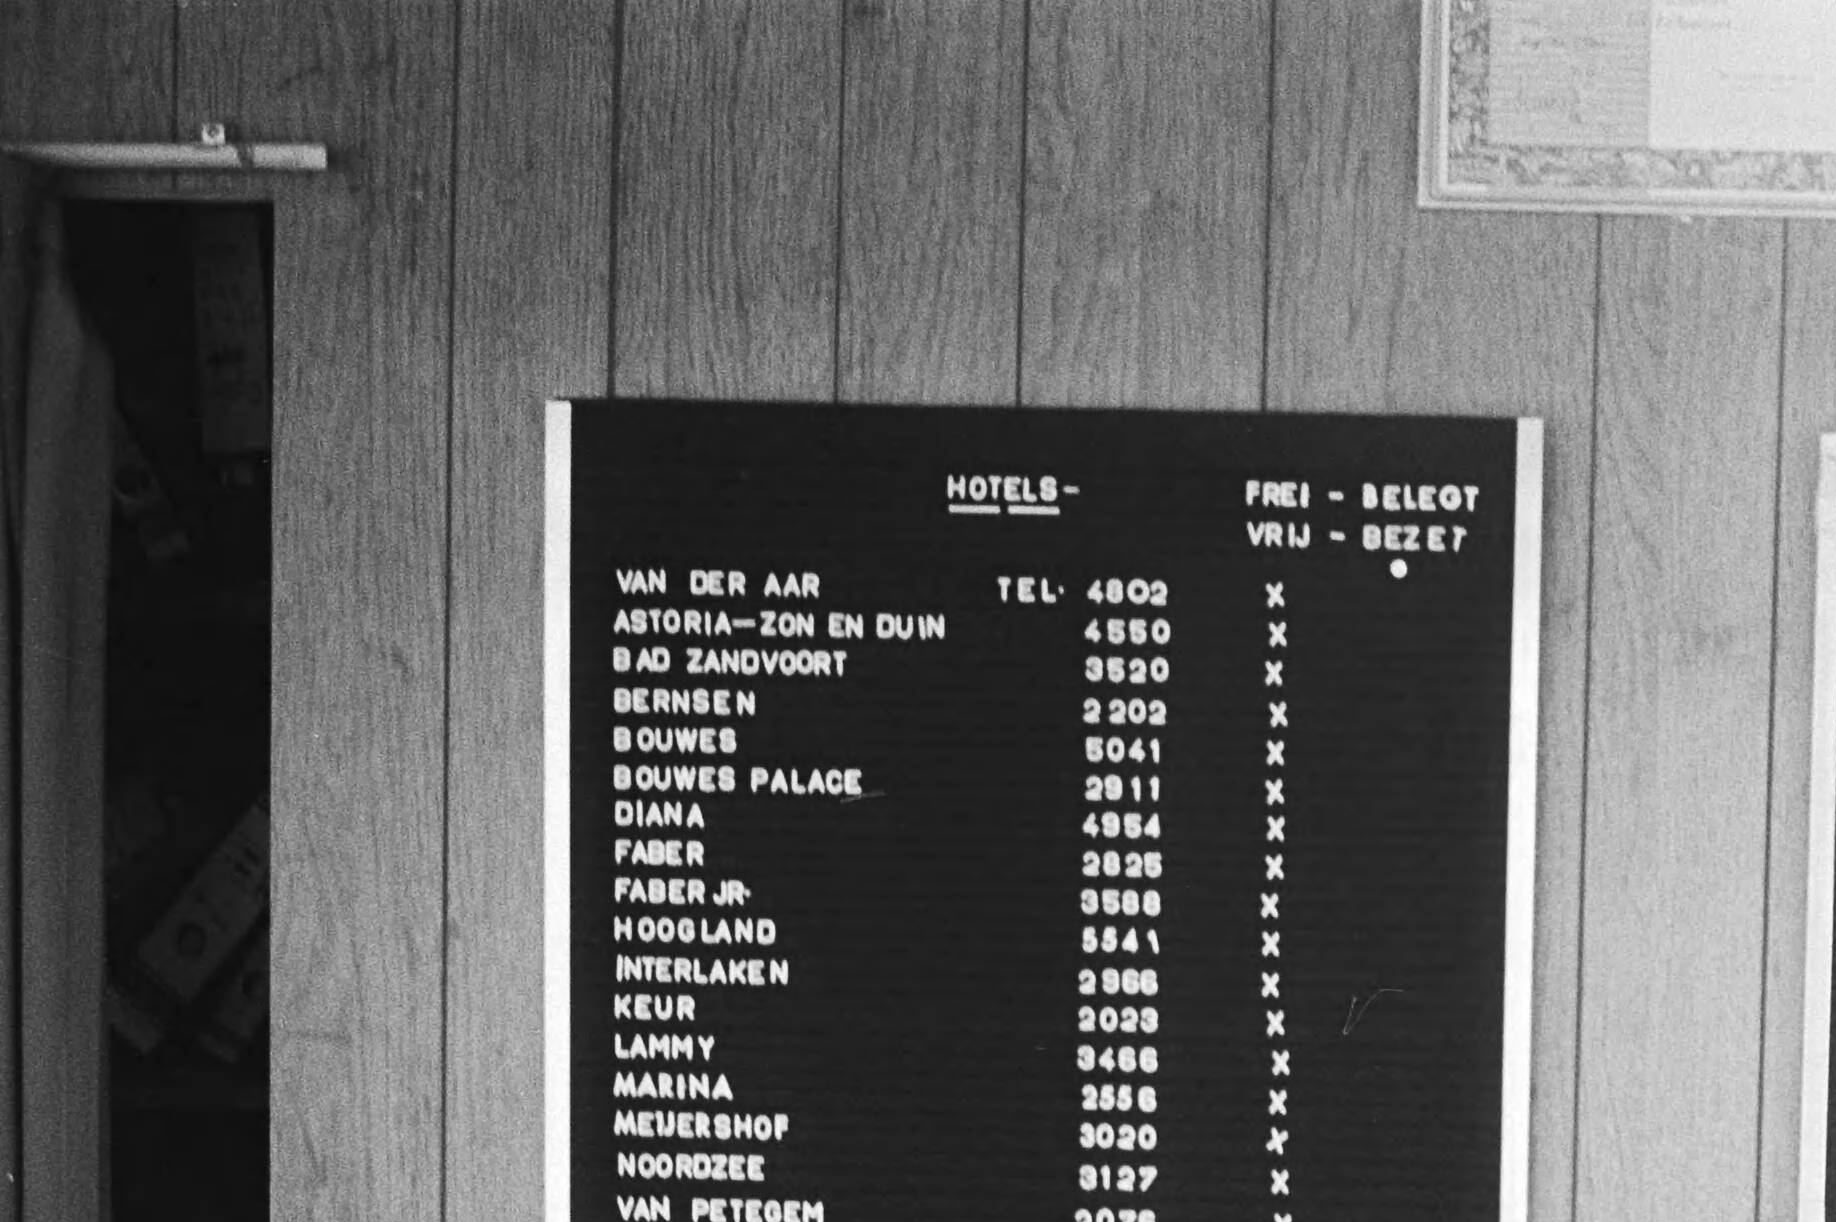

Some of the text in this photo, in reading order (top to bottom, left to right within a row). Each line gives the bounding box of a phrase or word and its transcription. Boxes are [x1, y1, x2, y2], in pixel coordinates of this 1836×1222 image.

[1245, 479, 1311, 509] FREI
[1361, 482, 1480, 513] BELEGT
[1246, 521, 1311, 549] VRIJ
[1362, 524, 1468, 553] BEZET
[616, 568, 667, 595] VAN
[689, 569, 746, 597] DER
[763, 572, 820, 598] AAR
[827, 611, 864, 640] EN
[875, 612, 946, 641] DUIN
[1084, 618, 1171, 645] 4550
[612, 646, 1170, 684] BAD ZANDVOORT 3520
[613, 687, 1167, 726] BERNSEN 2202
[613, 726, 1161, 764] BOUWES 5041
[613, 764, 736, 793] BOUWES
[750, 766, 863, 796] PALACE
[614, 799, 705, 829] DIANA
[614, 838, 705, 867] FABER
[614, 876, 706, 906] FABER
[613, 915, 777, 946] HOOGLAND
[1081, 925, 1160, 955] 5541
[615, 953, 789, 986] INTERLAKEN
[613, 993, 1159, 1034] KEUR 2023
[614, 1032, 715, 1062] LAMMY
[612, 1071, 734, 1102] MARINA
[613, 1109, 1158, 1151] MEIJERSHOF 3020
[617, 1151, 1158, 1193] NOORDZEE 3127
[616, 1195, 671, 1222] VAN
